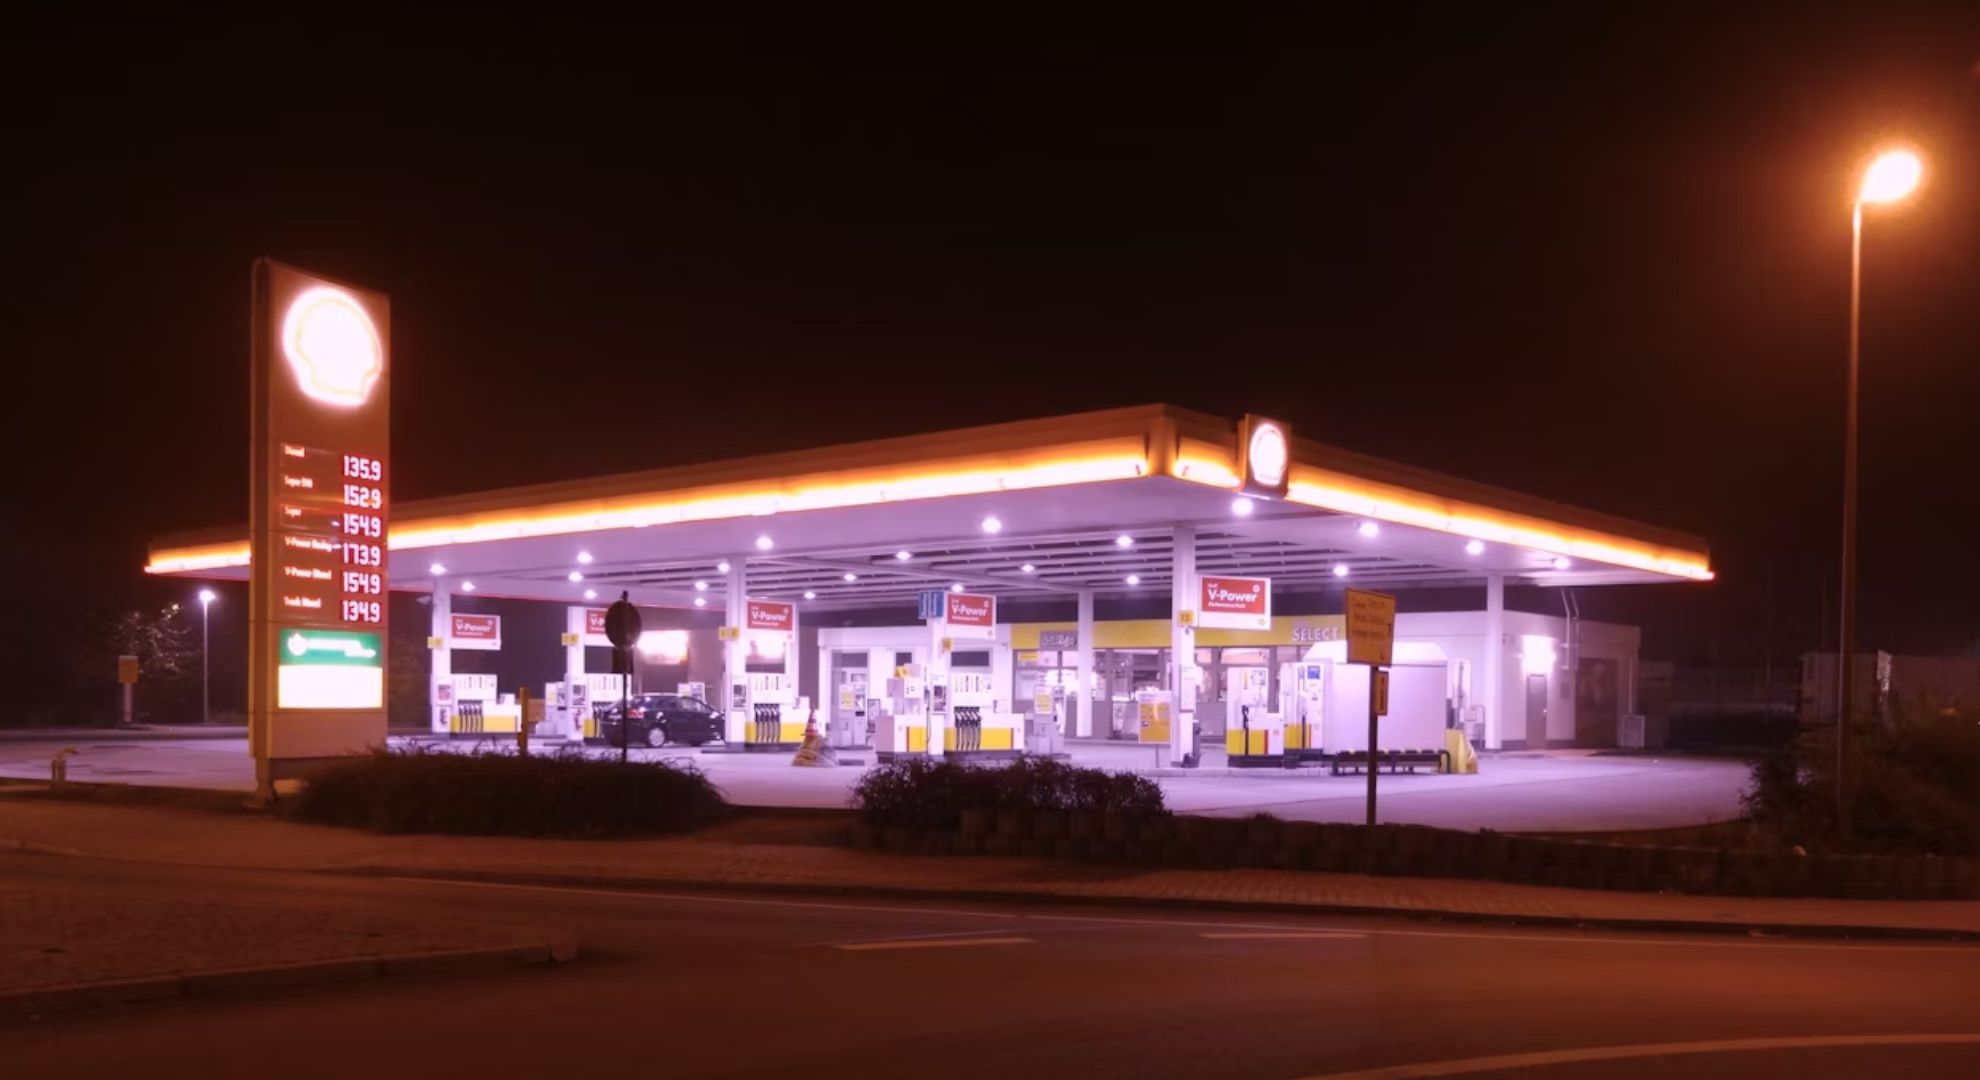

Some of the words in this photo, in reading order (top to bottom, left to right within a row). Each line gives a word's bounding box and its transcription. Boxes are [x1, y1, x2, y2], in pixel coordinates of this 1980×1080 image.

[343, 455, 382, 481] 135.9
[343, 543, 381, 566] 173.9
[1207, 588, 1258, 602] V-Power
[751, 610, 787, 622] V-Power
[951, 602, 988, 617] V-Power
[456, 622, 491, 633] V-Power
[1292, 626, 1339, 641] SELECT
